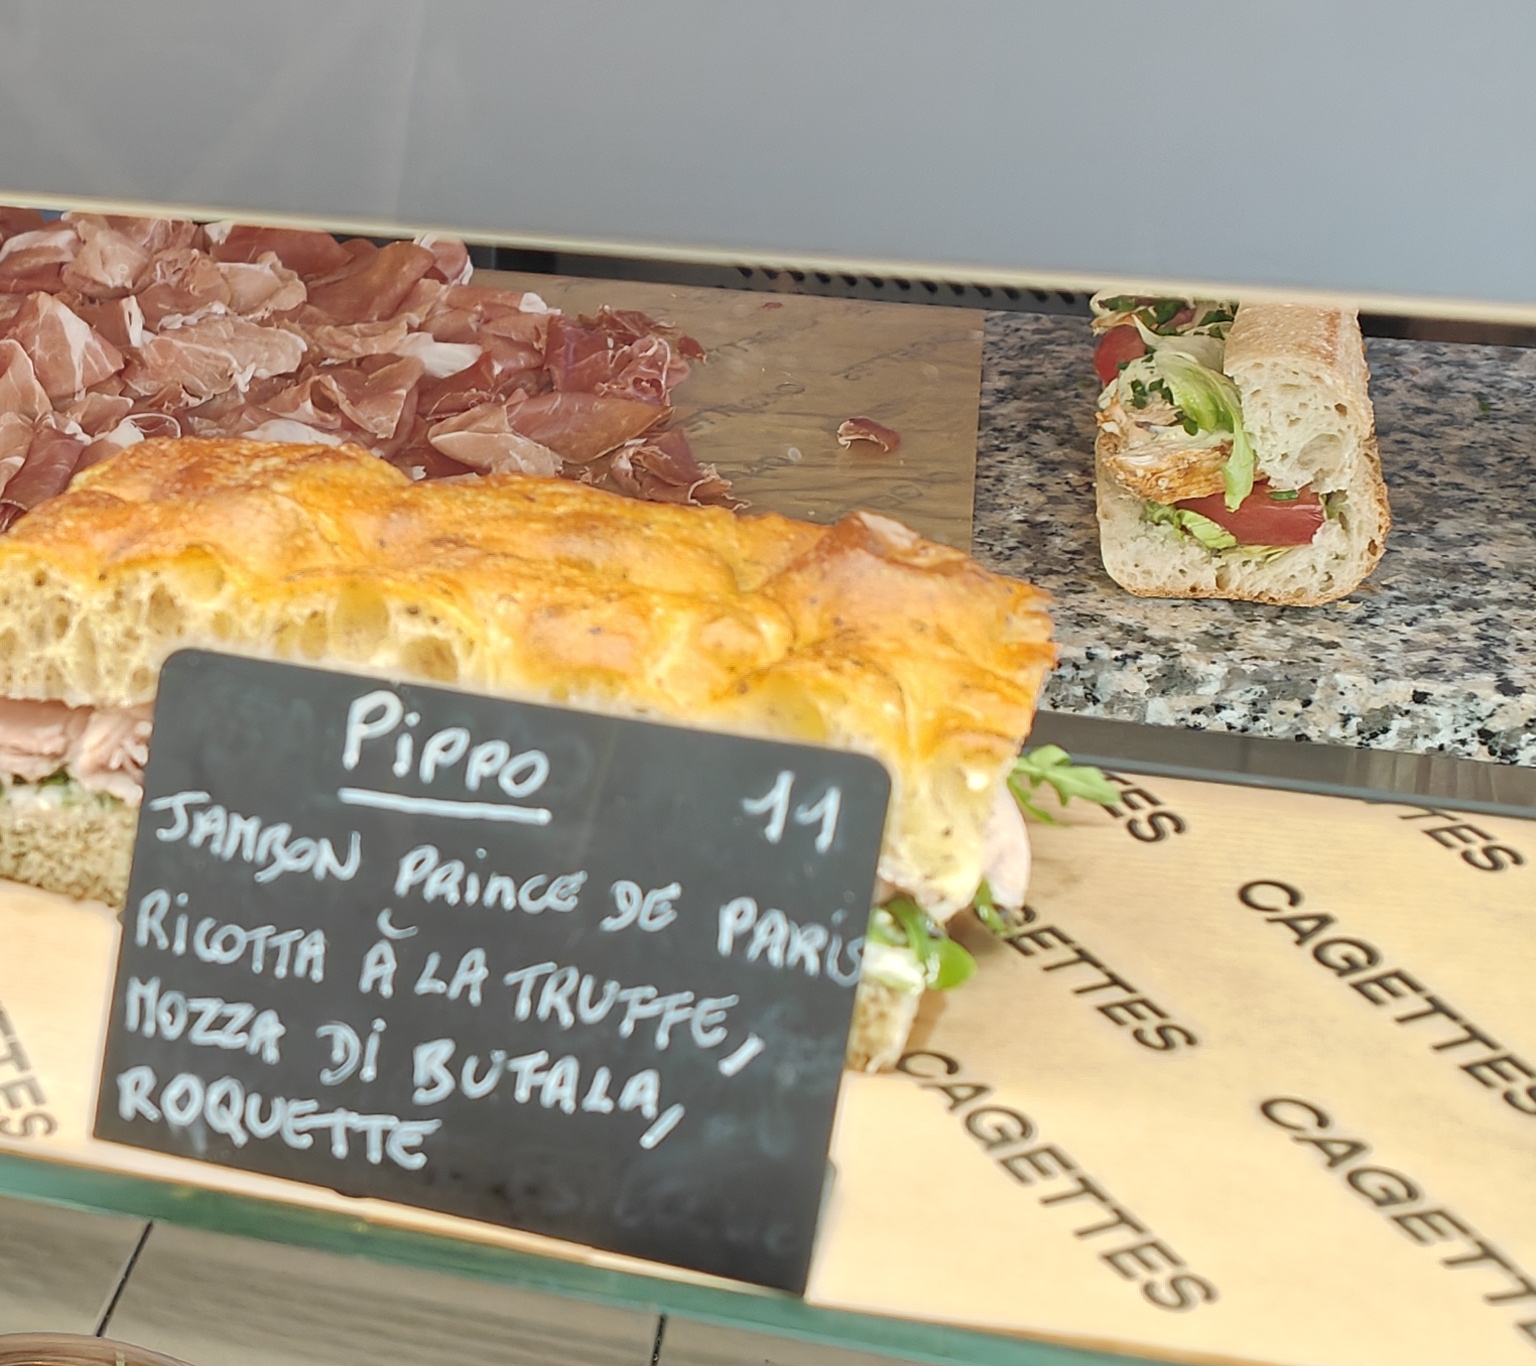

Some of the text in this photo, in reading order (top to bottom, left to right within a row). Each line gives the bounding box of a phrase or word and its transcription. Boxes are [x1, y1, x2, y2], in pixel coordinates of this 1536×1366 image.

[151, 790, 362, 884] JAMBON
[599, 879, 682, 933] DE
[742, 770, 843, 854] 11
[125, 975, 286, 1065] MOZZA
[413, 946, 490, 1008] LA
[503, 960, 766, 1077] TRUFFE,
[116, 1064, 443, 1170] ROQUETTE
[897, 1049, 1219, 1313] CAGETTES
